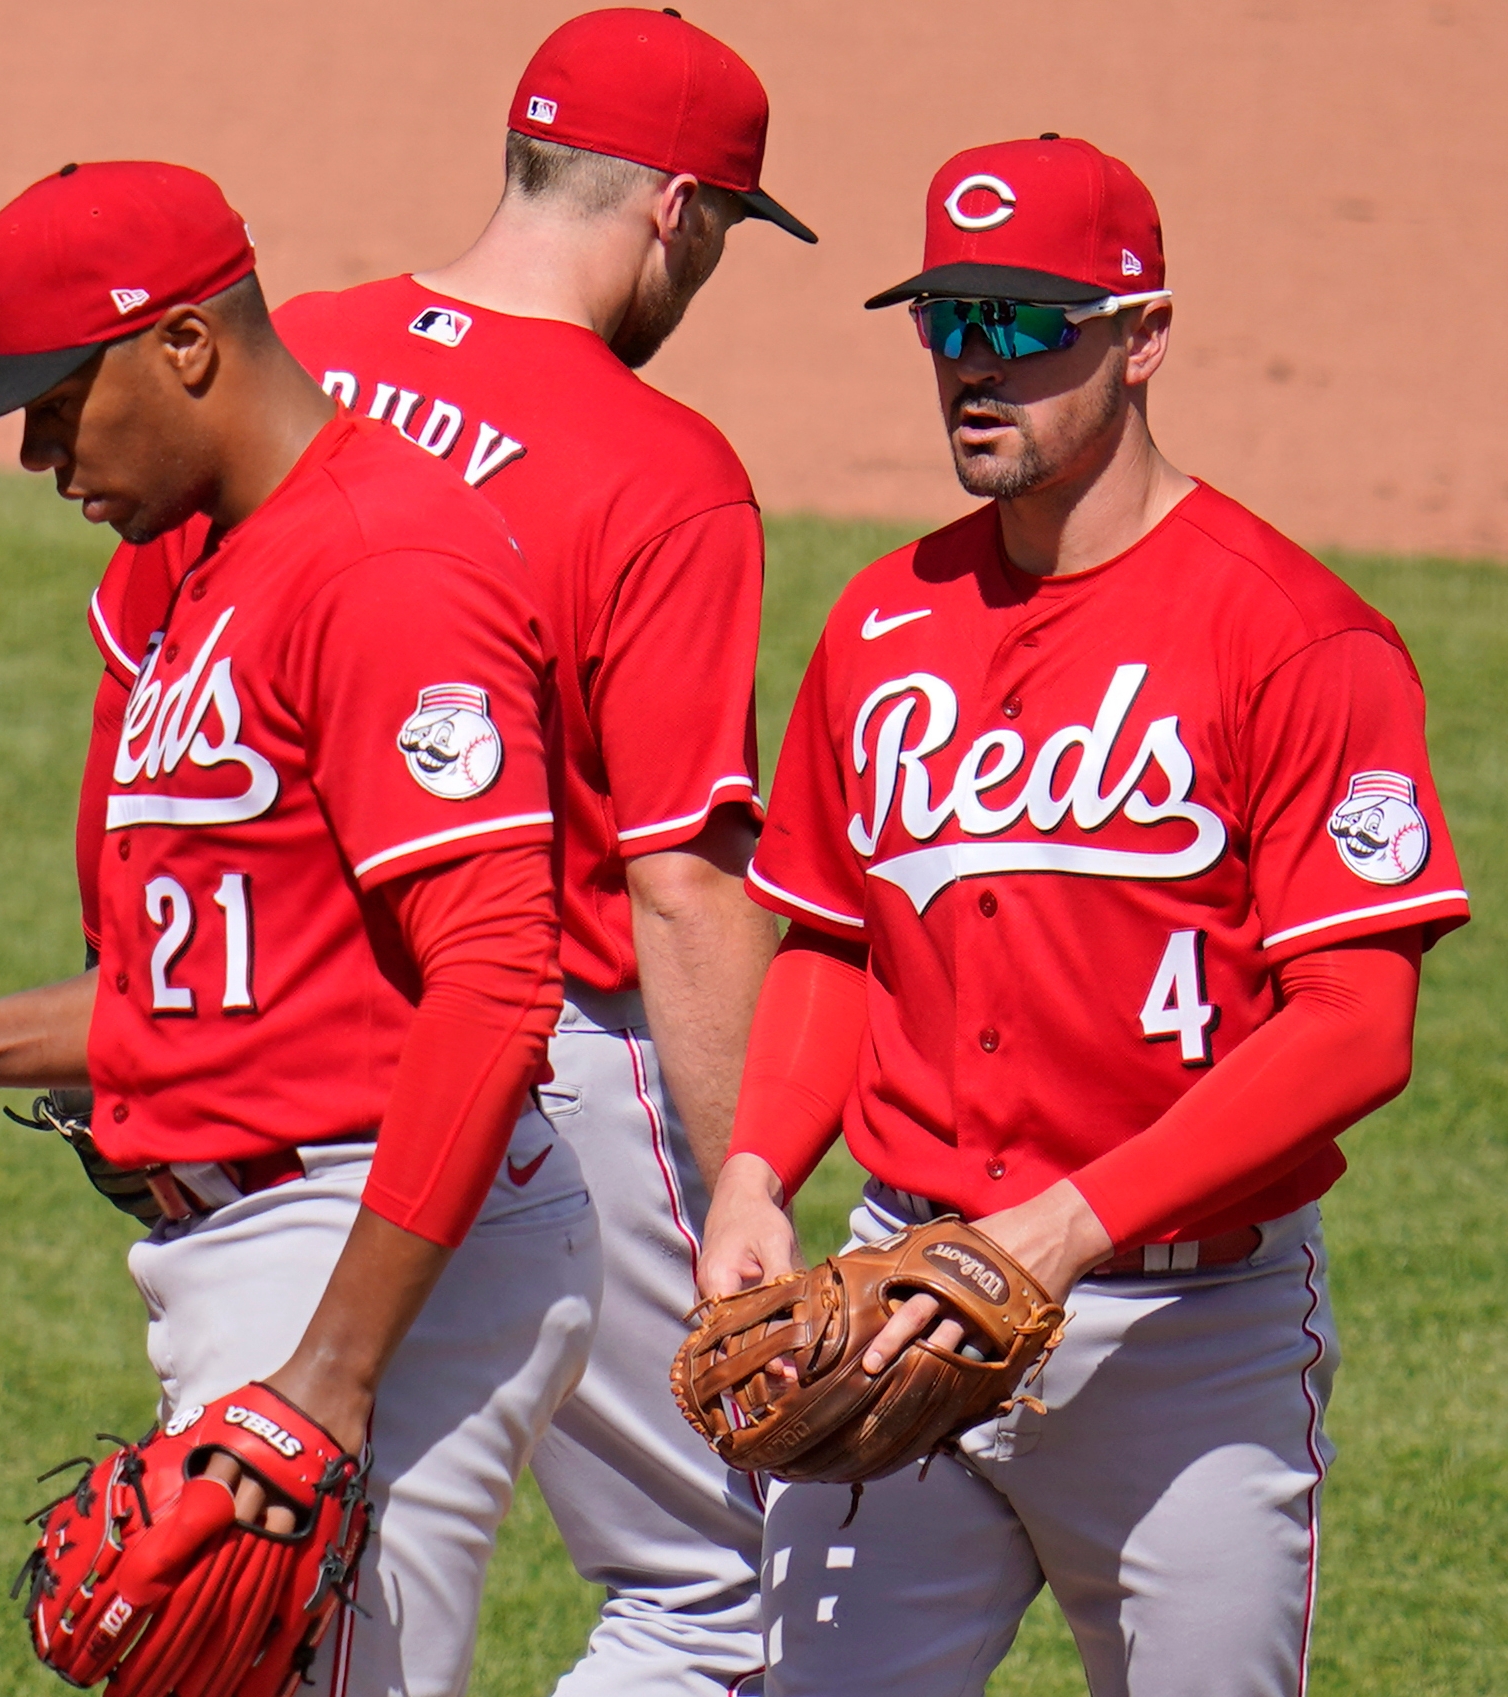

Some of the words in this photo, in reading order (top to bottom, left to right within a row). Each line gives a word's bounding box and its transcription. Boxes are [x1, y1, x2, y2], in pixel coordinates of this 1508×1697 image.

[943, 173, 1017, 232] C
[106, 606, 280, 832] eds
[847, 663, 1229, 916] Reds
[144, 873, 257, 1016] 21
[1138, 929, 1221, 1067] 4
[930, 1243, 1005, 1301] Wilson
